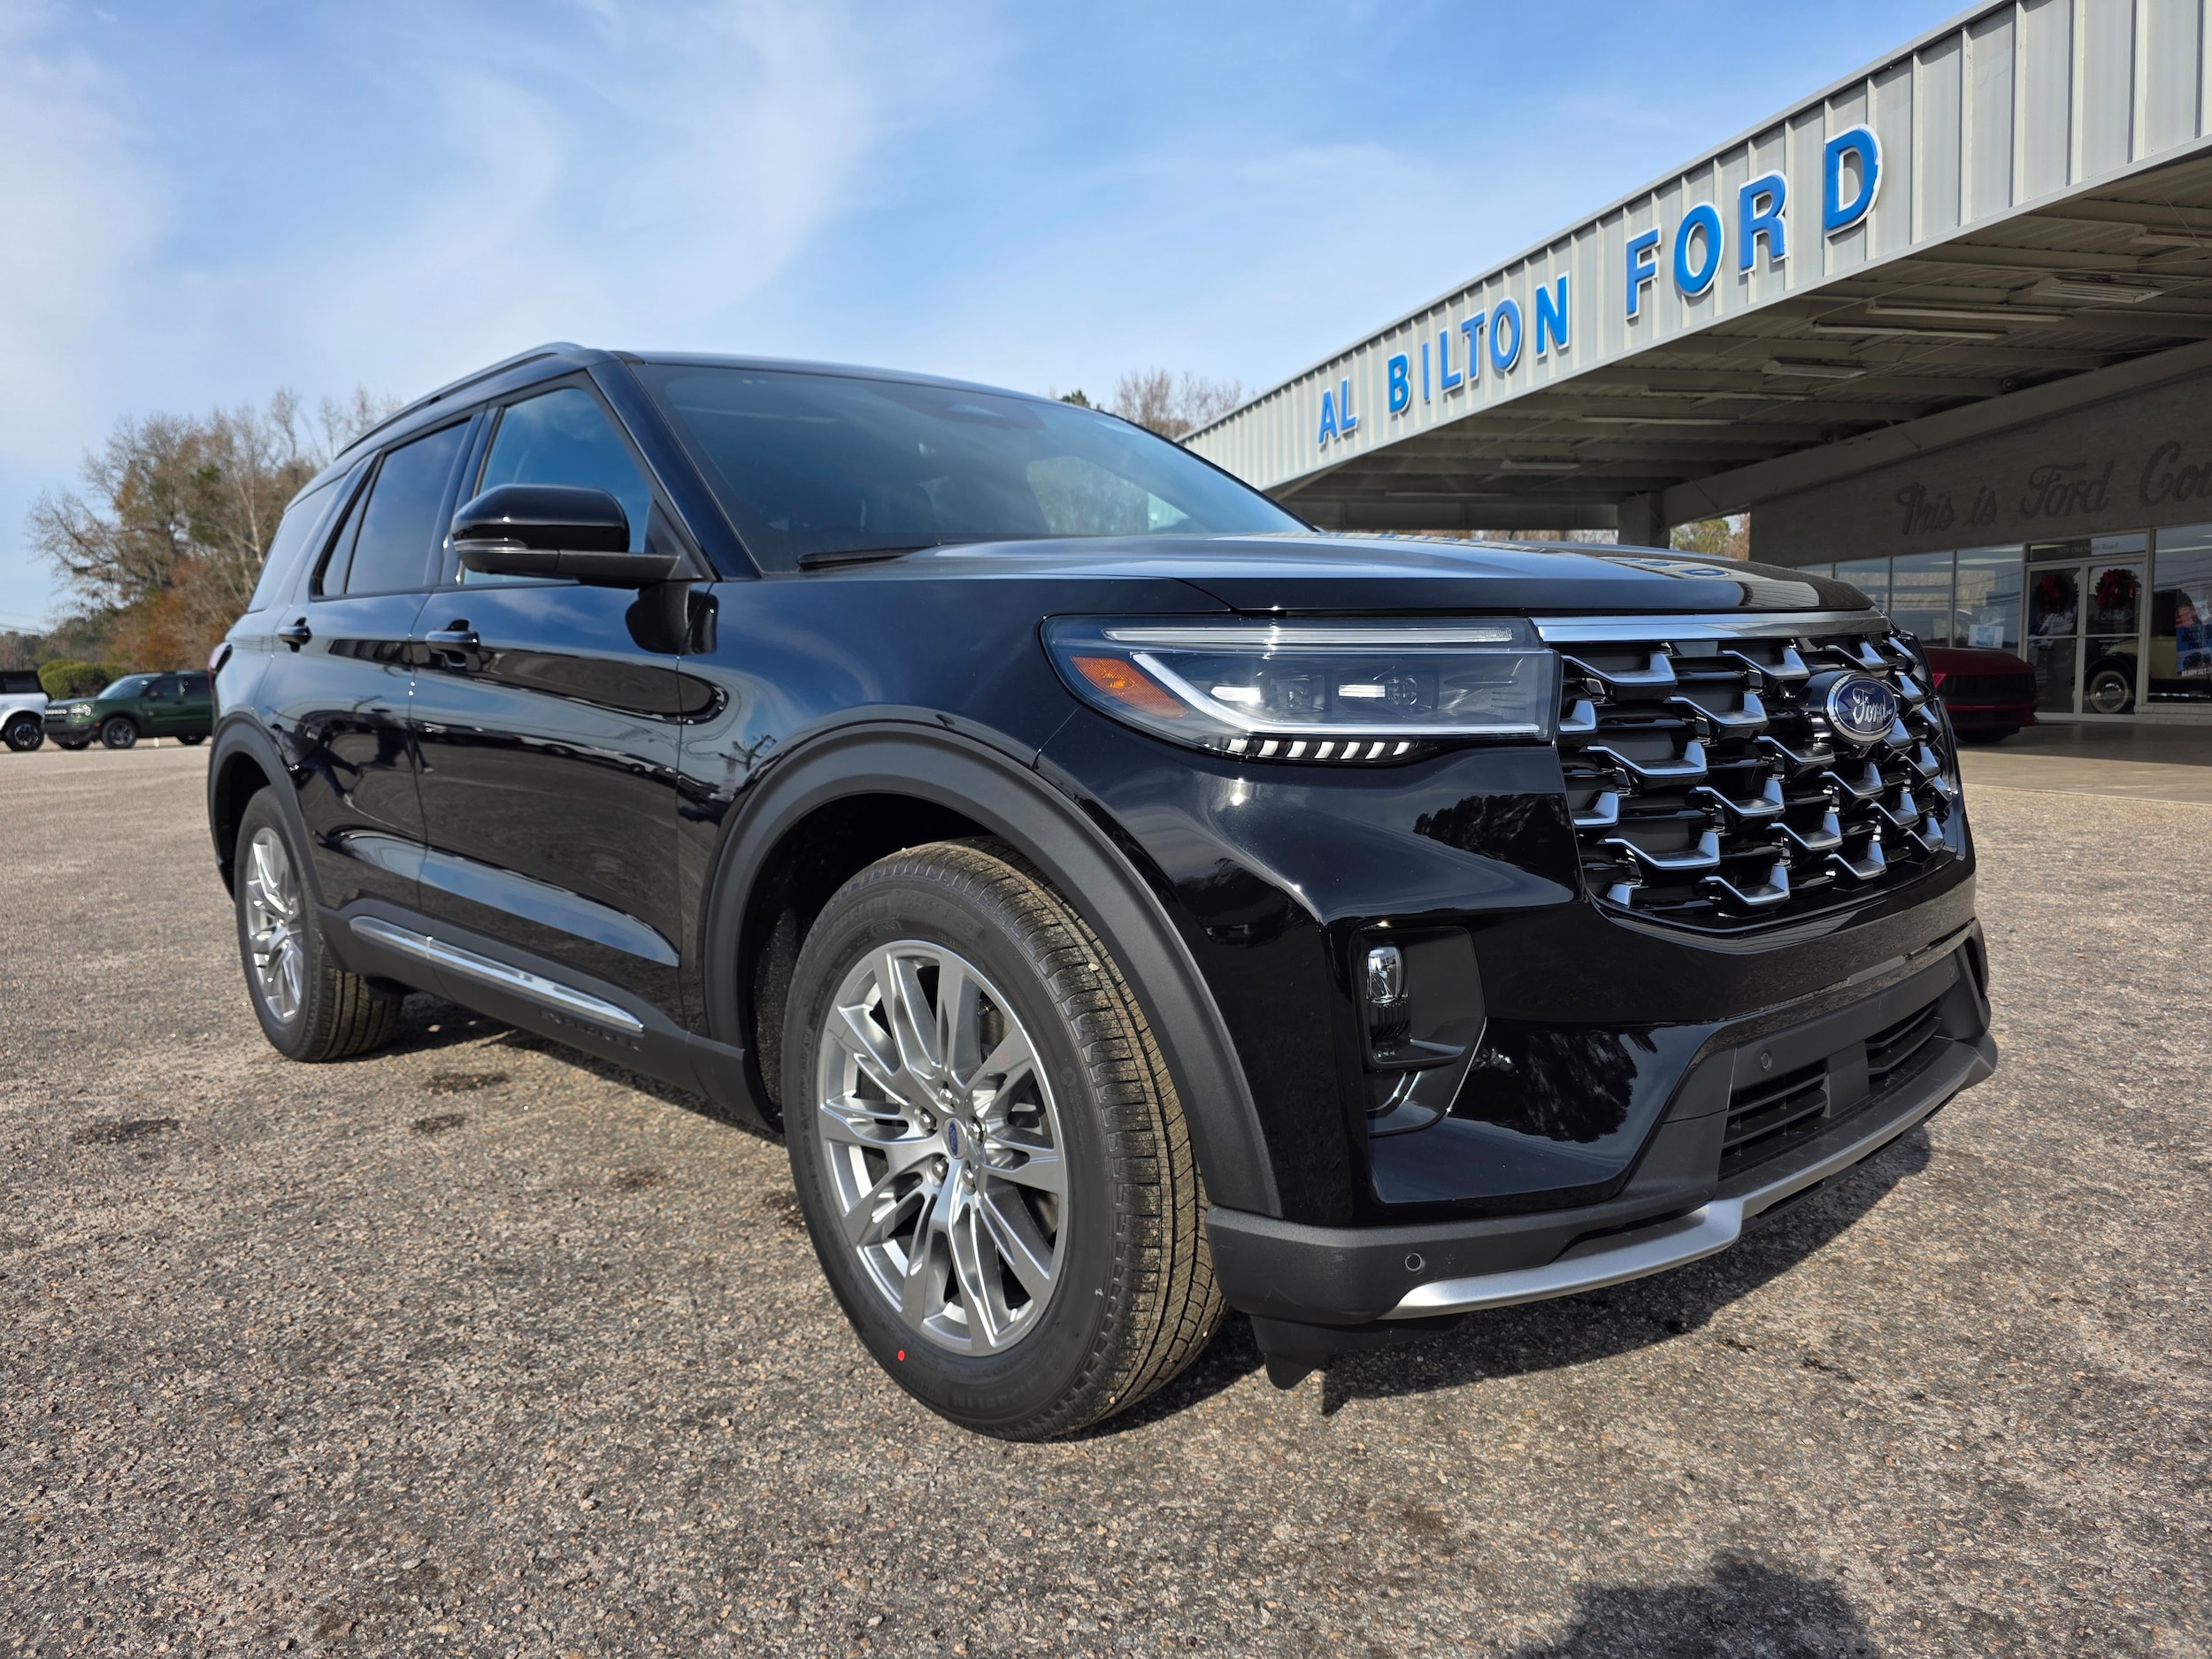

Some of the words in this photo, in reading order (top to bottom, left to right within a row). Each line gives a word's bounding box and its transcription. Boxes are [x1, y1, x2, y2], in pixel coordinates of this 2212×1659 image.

[1317, 376, 1359, 446] AL
[1387, 273, 1571, 416] BILTON
[1625, 122, 1884, 320] FORD
[1895, 480, 1955, 536] This
[1963, 486, 1998, 526] is
[2018, 458, 2116, 520] Ford
[1852, 687, 1893, 726] Ford
